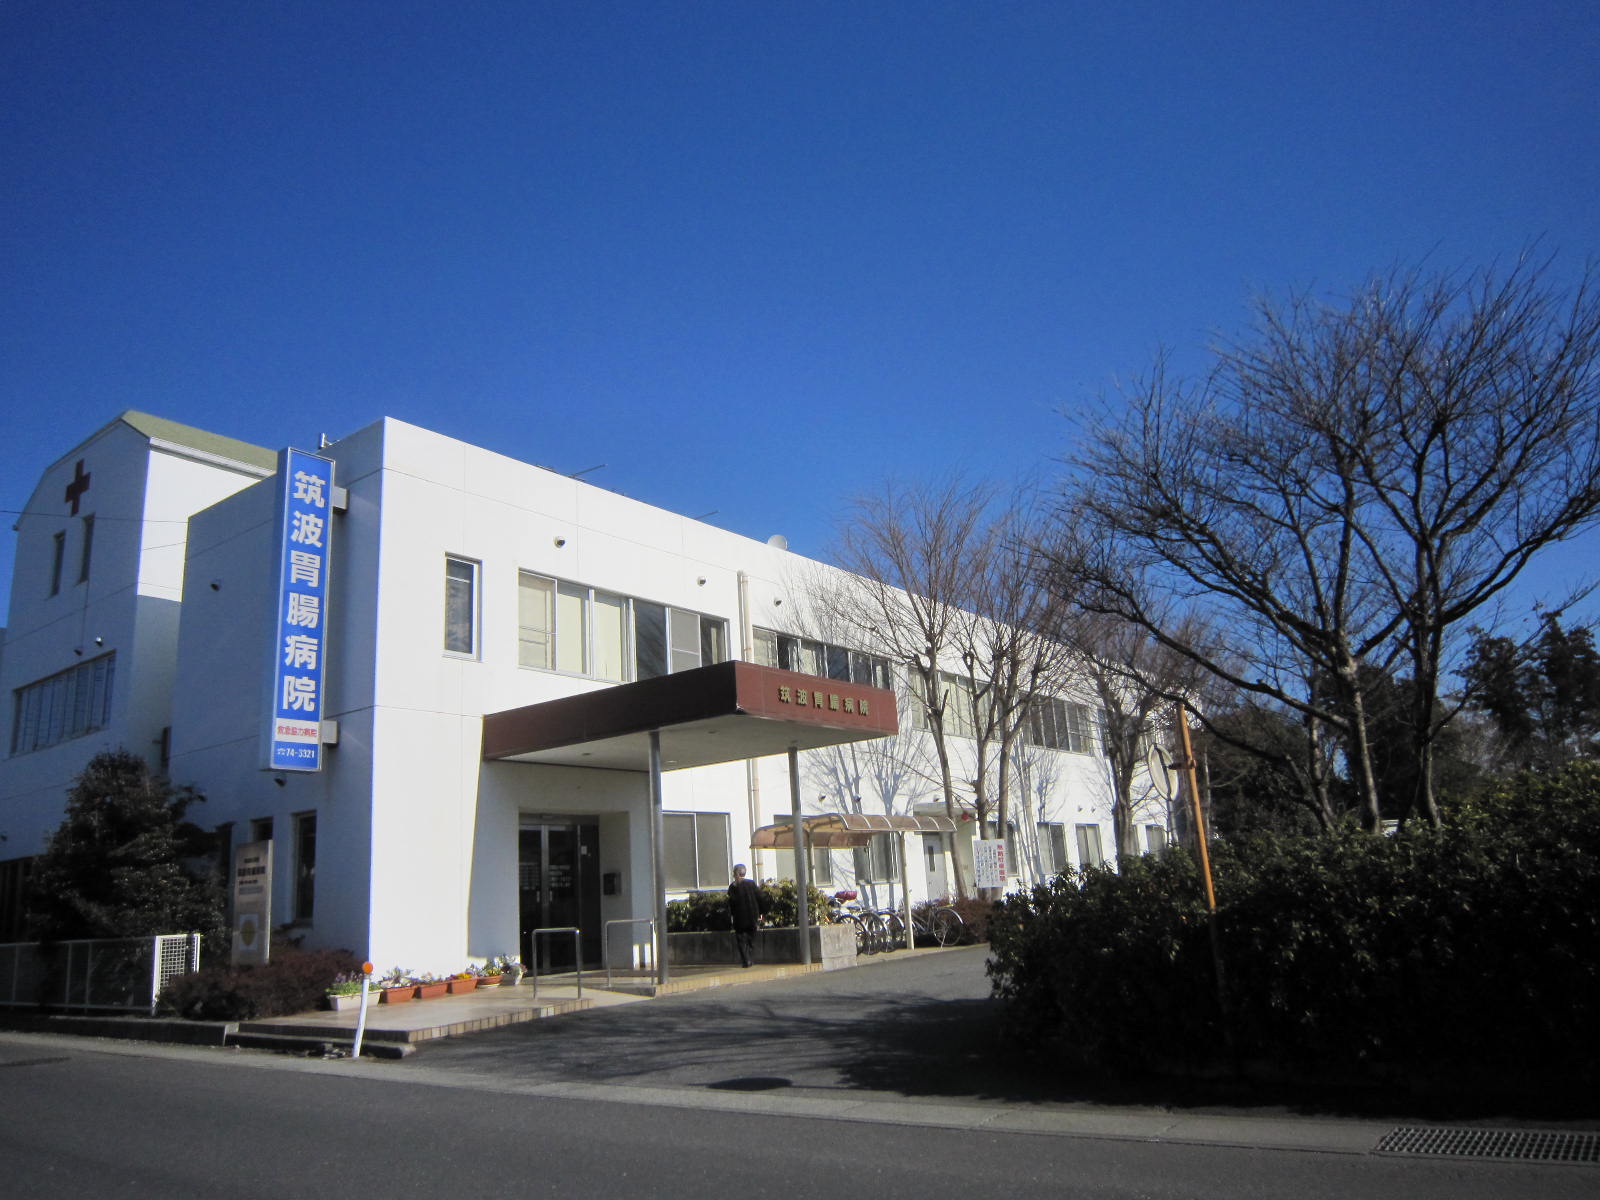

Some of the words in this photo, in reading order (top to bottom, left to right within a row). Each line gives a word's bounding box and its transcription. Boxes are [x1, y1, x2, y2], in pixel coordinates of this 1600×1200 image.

[282, 470, 325, 712] 筑波胃腸病院
[778, 685, 869, 716] 筑波胃腸病院
